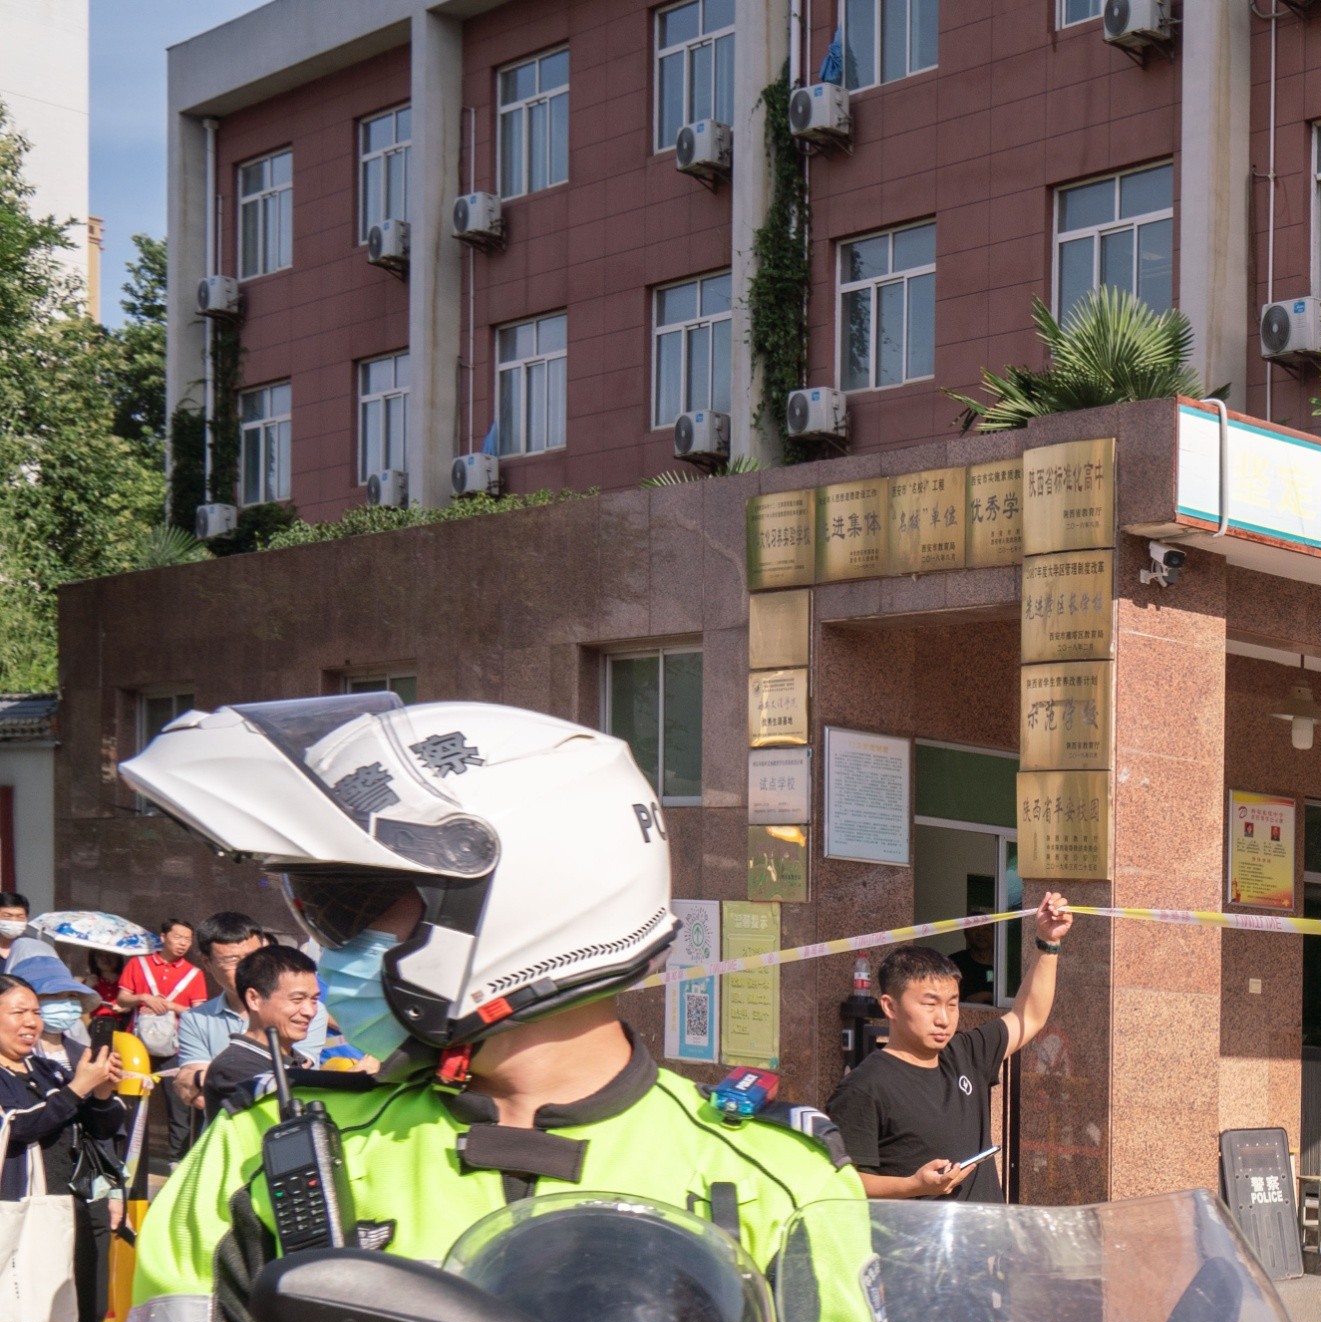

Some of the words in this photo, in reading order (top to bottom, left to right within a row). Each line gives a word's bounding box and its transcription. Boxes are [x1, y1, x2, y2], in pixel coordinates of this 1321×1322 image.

[970, 493, 1023, 524] 优秀学
[1250, 1190, 1284, 1204] POLICE
